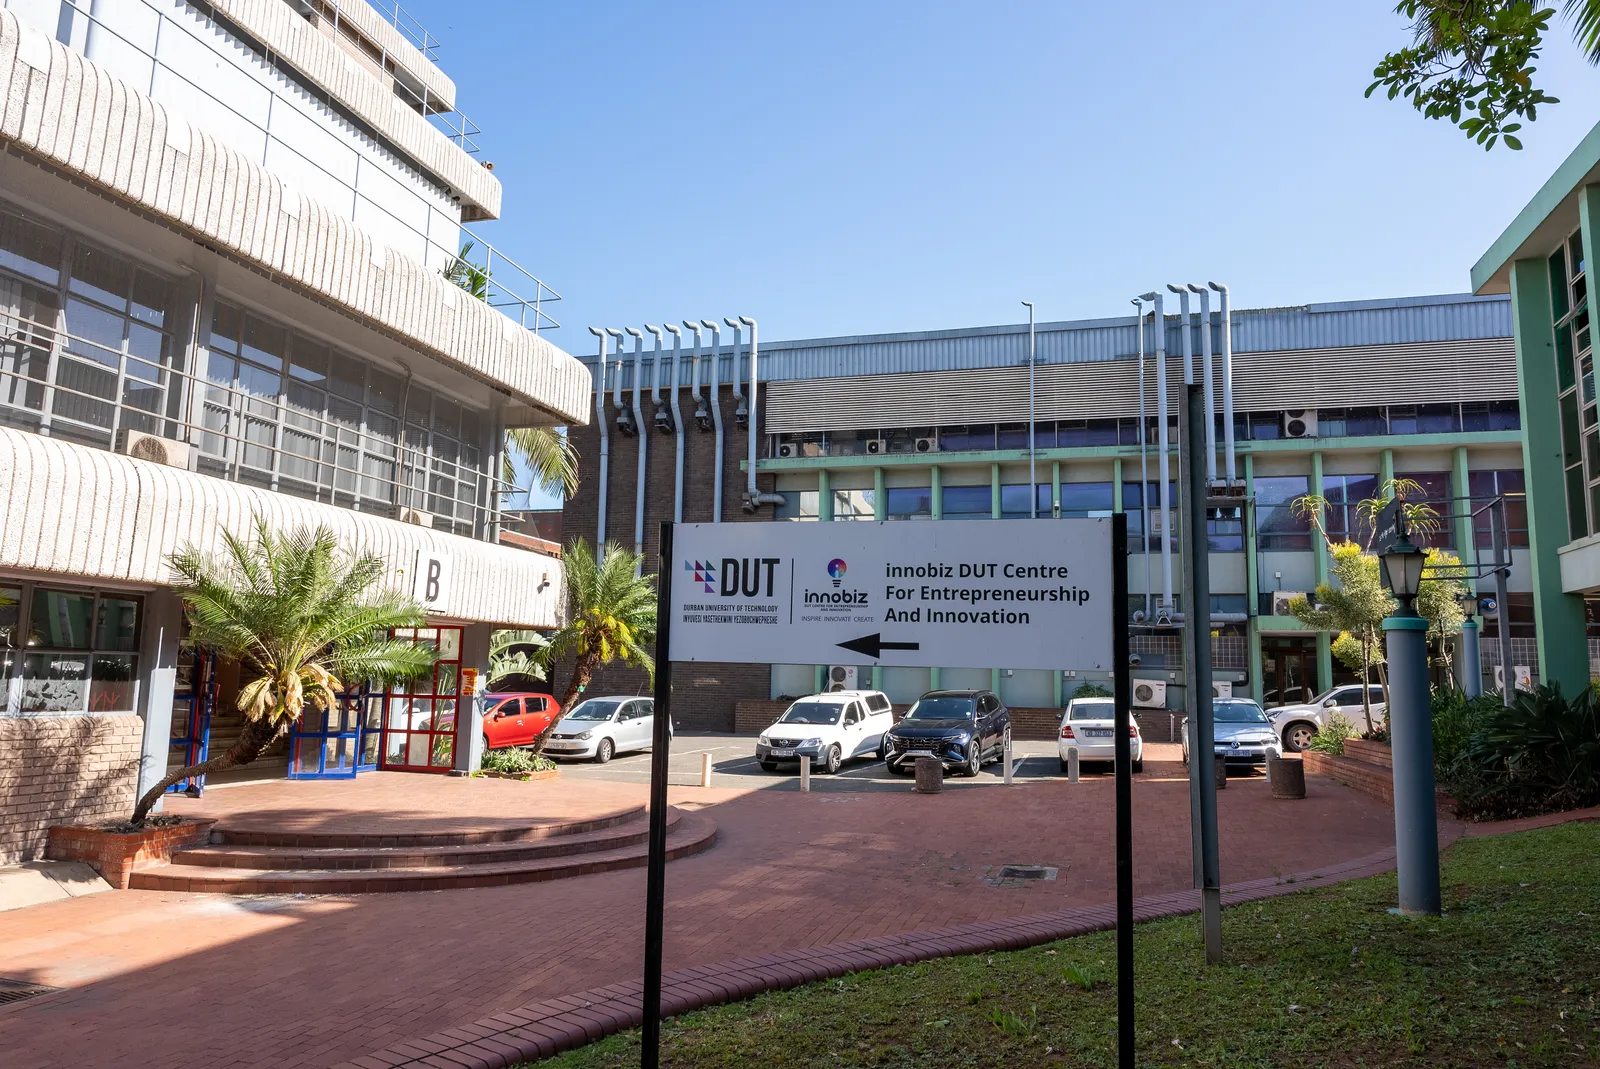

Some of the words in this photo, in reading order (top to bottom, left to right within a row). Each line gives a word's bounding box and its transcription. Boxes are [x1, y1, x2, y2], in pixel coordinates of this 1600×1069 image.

[721, 558, 780, 597] DUT
[886, 562, 954, 578] innobiz
[959, 563, 998, 578] DUT
[1003, 563, 1068, 579] Centre
[425, 559, 441, 602] B
[804, 589, 868, 604] innobiz
[886, 585, 915, 600] For
[920, 585, 1090, 605] Entrepreneurship
[705, 604, 736, 612] UNIVERSITY
[884, 607, 921, 623] And
[927, 607, 1030, 624] Innovation
